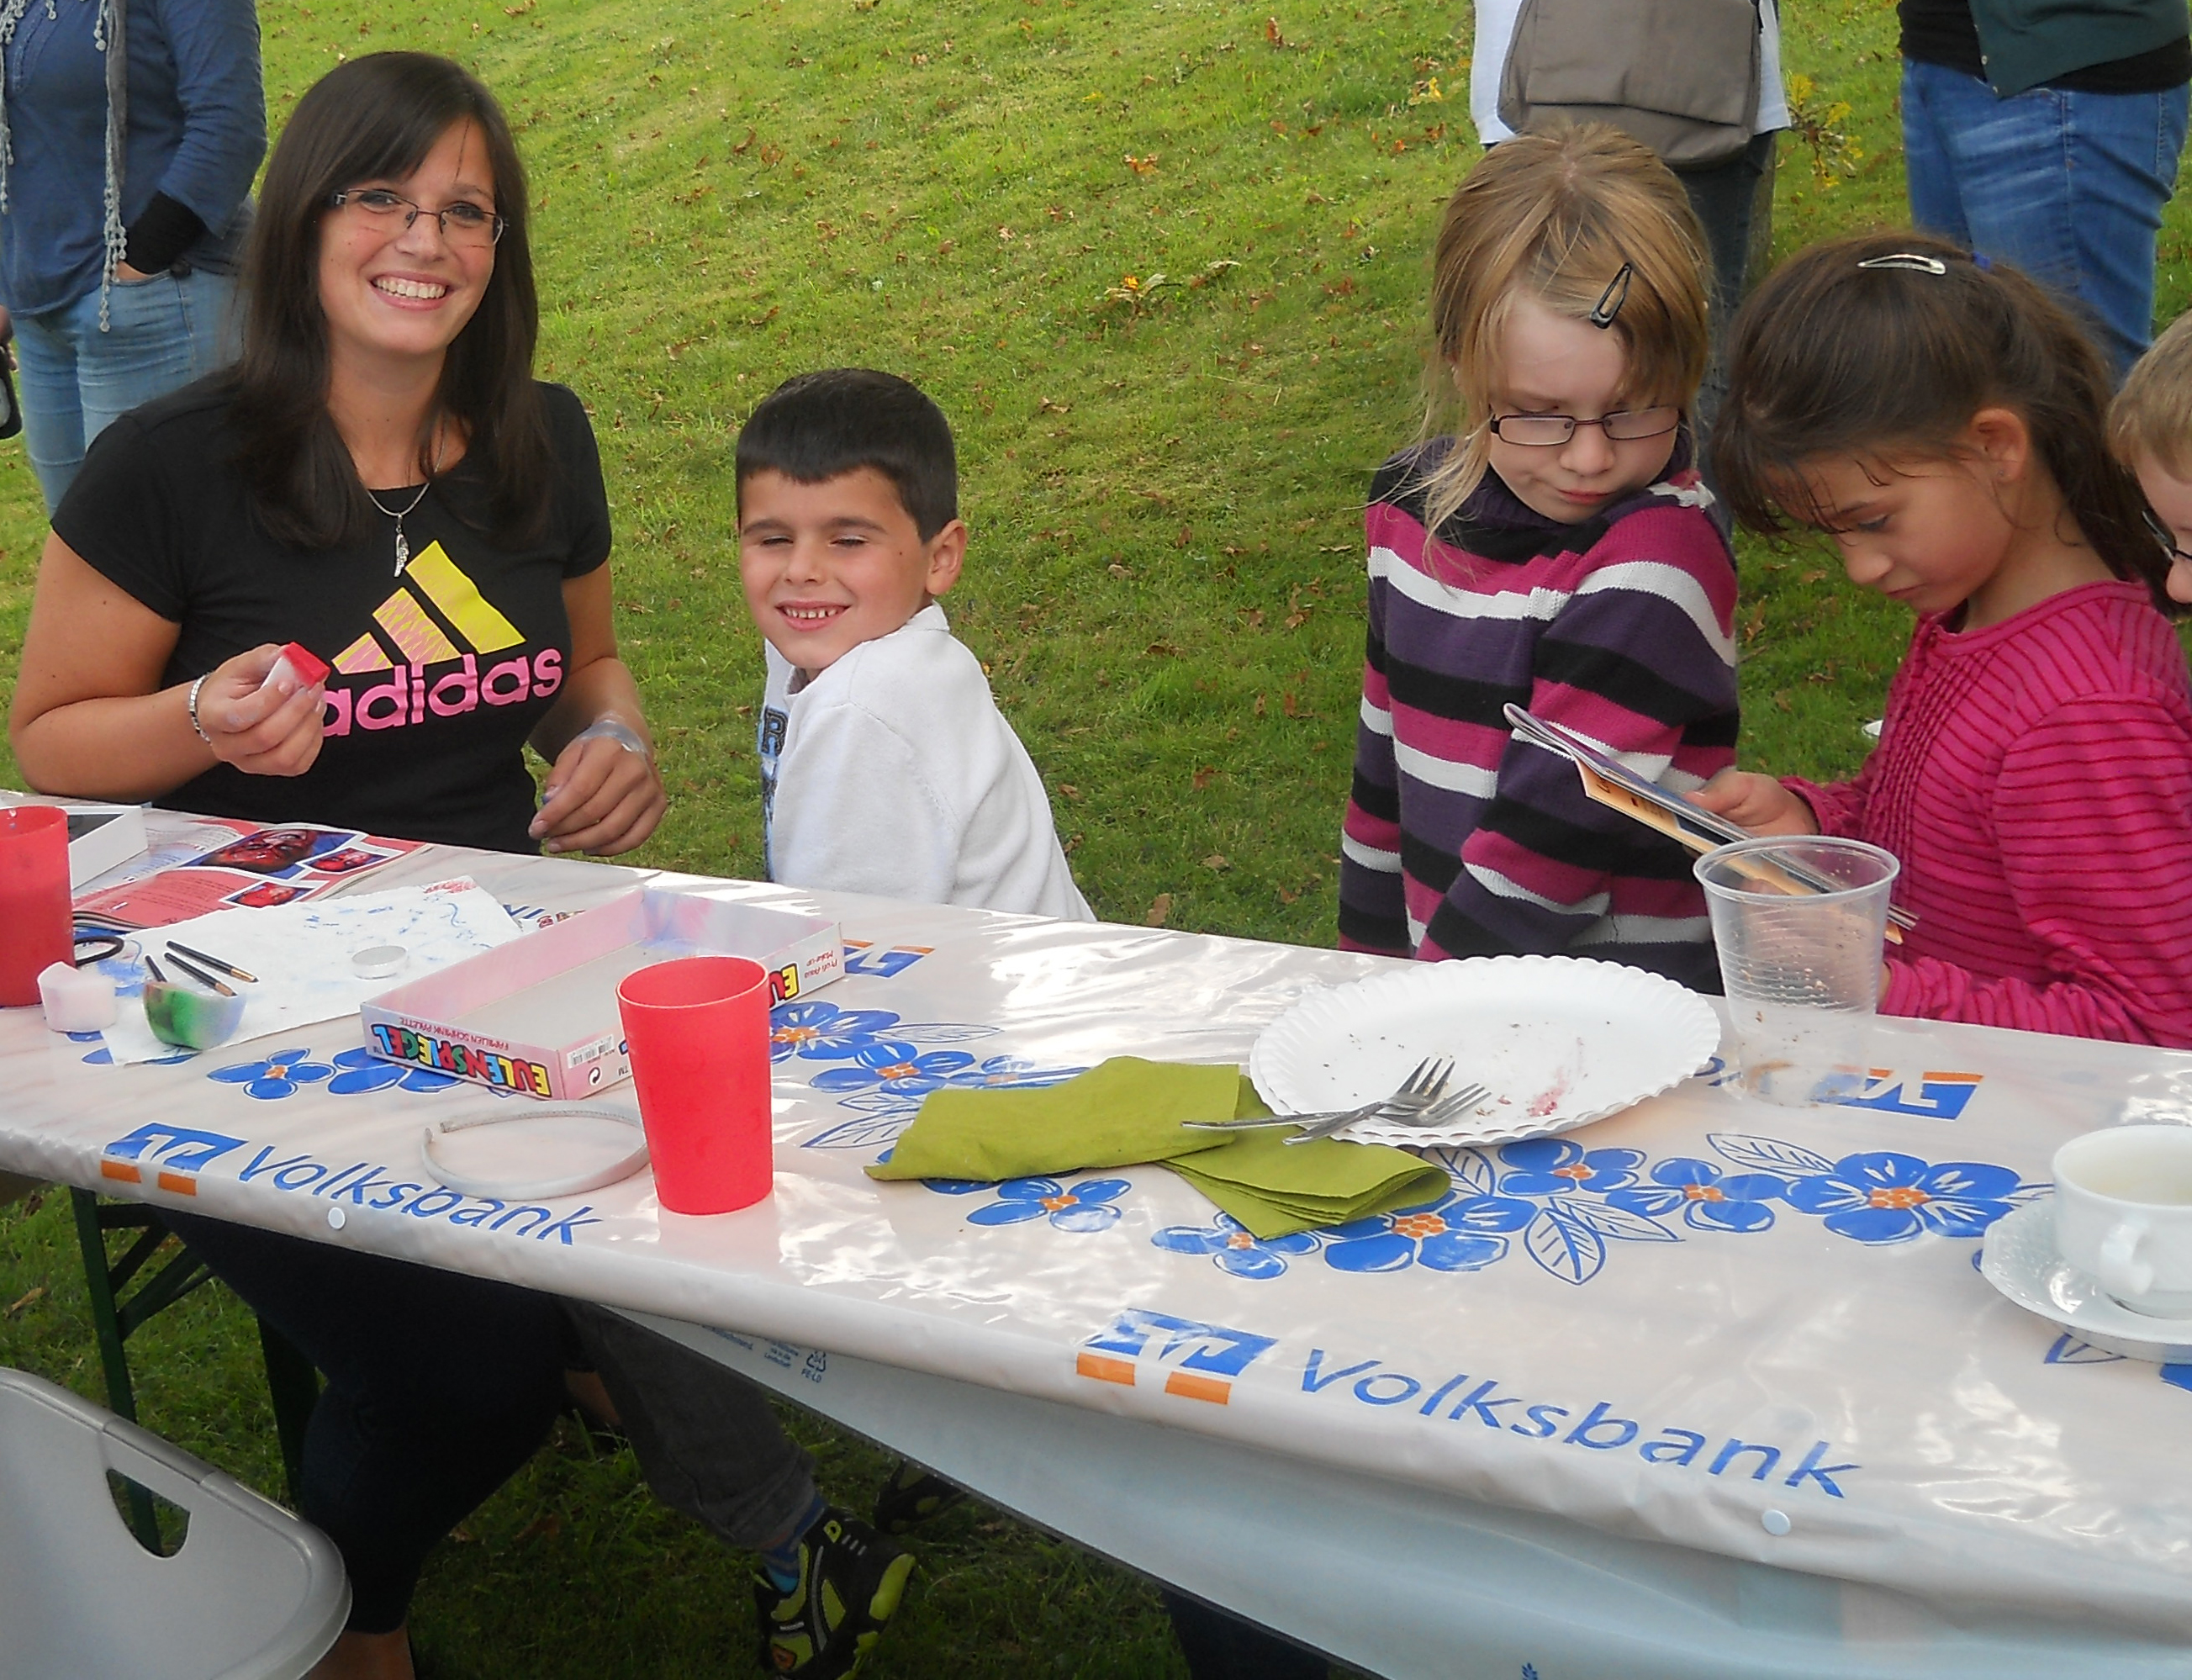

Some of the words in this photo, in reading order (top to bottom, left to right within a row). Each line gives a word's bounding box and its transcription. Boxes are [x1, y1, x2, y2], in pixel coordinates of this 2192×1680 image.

[323, 648, 563, 737] adidas
[371, 1023, 552, 1097] EULENSPIEGEL
[399, 1017, 433, 1034] PALETTE
[433, 1025, 471, 1045] SCHMINK
[469, 1034, 510, 1051] FAMILIEN
[240, 1145, 603, 1244] Volksbank
[1301, 1348, 1862, 1498] Volksbank
